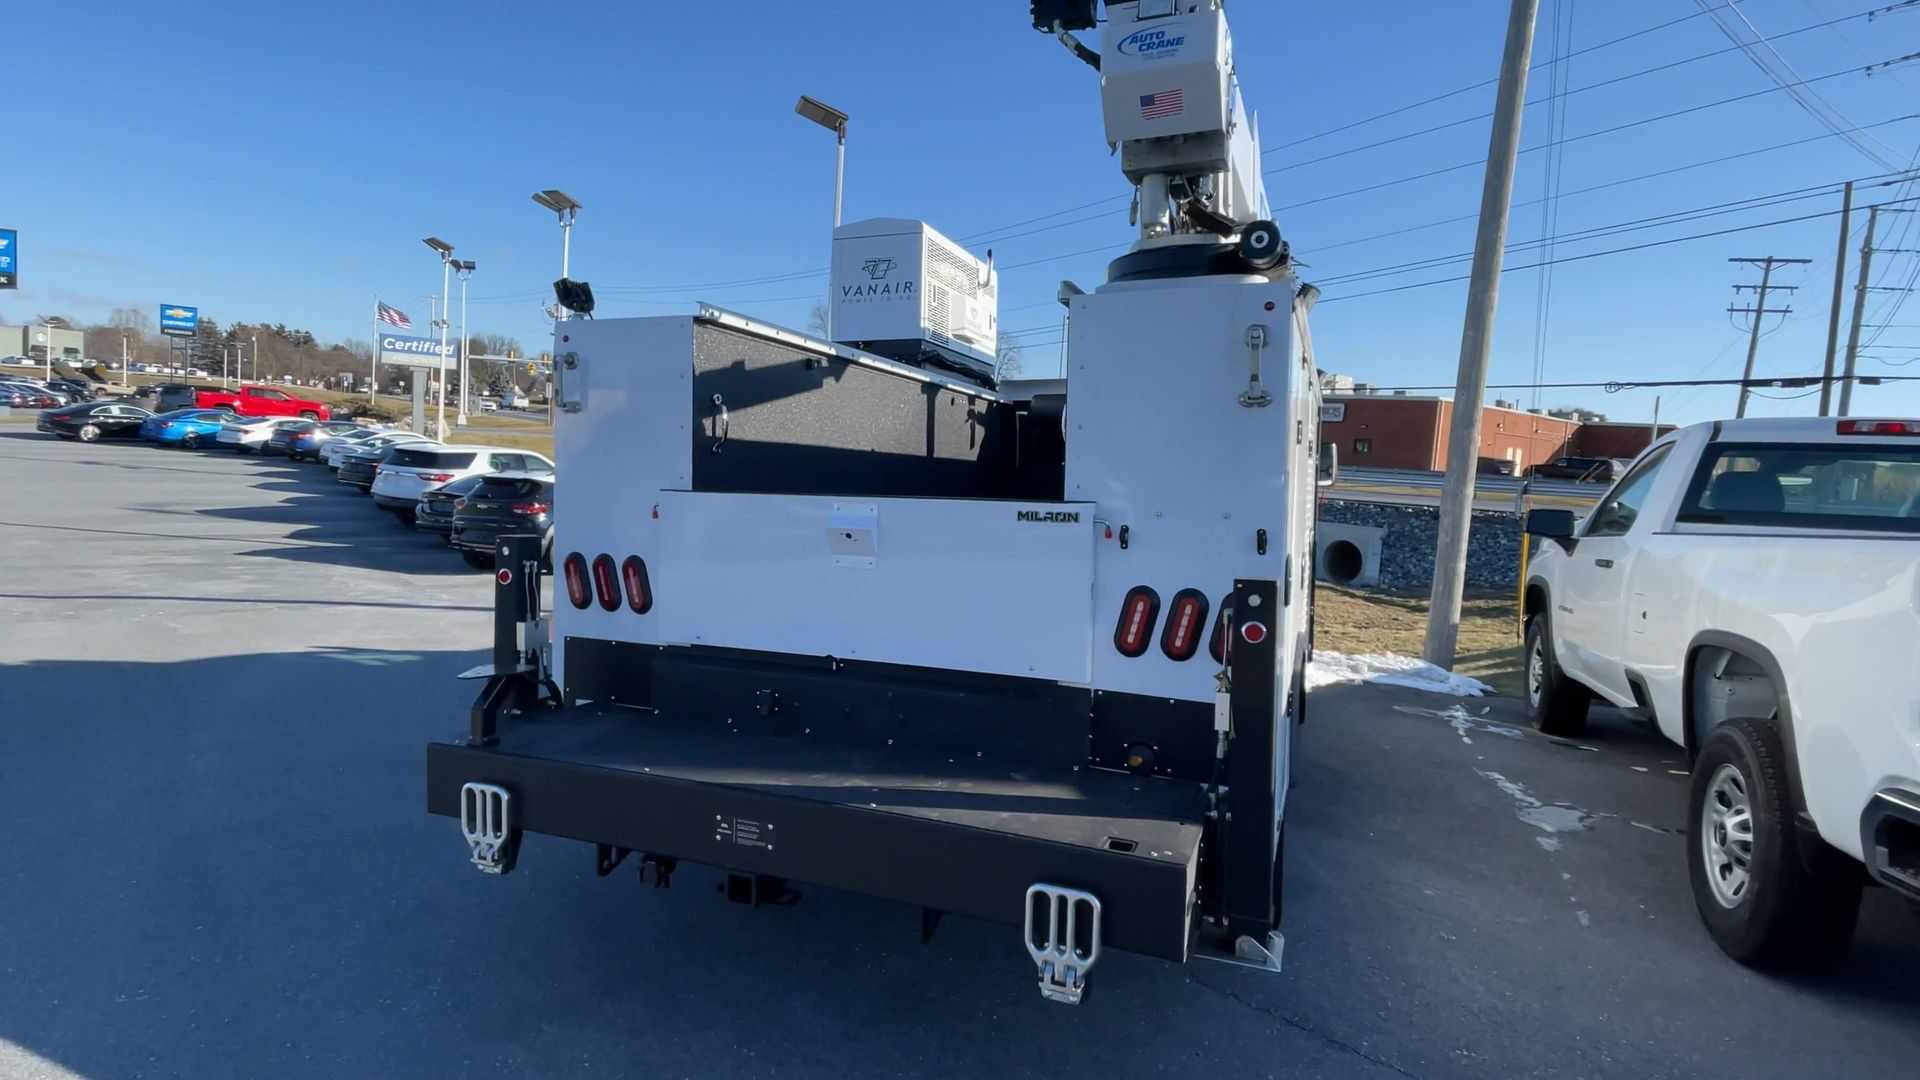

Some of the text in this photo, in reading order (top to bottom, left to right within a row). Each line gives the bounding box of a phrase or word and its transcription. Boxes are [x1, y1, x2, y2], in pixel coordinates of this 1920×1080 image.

[1128, 31, 1165, 45] AUTO
[1138, 36, 1185, 52] CRANE
[842, 281, 914, 297] VANAIR
[383, 337, 455, 355] Certified
